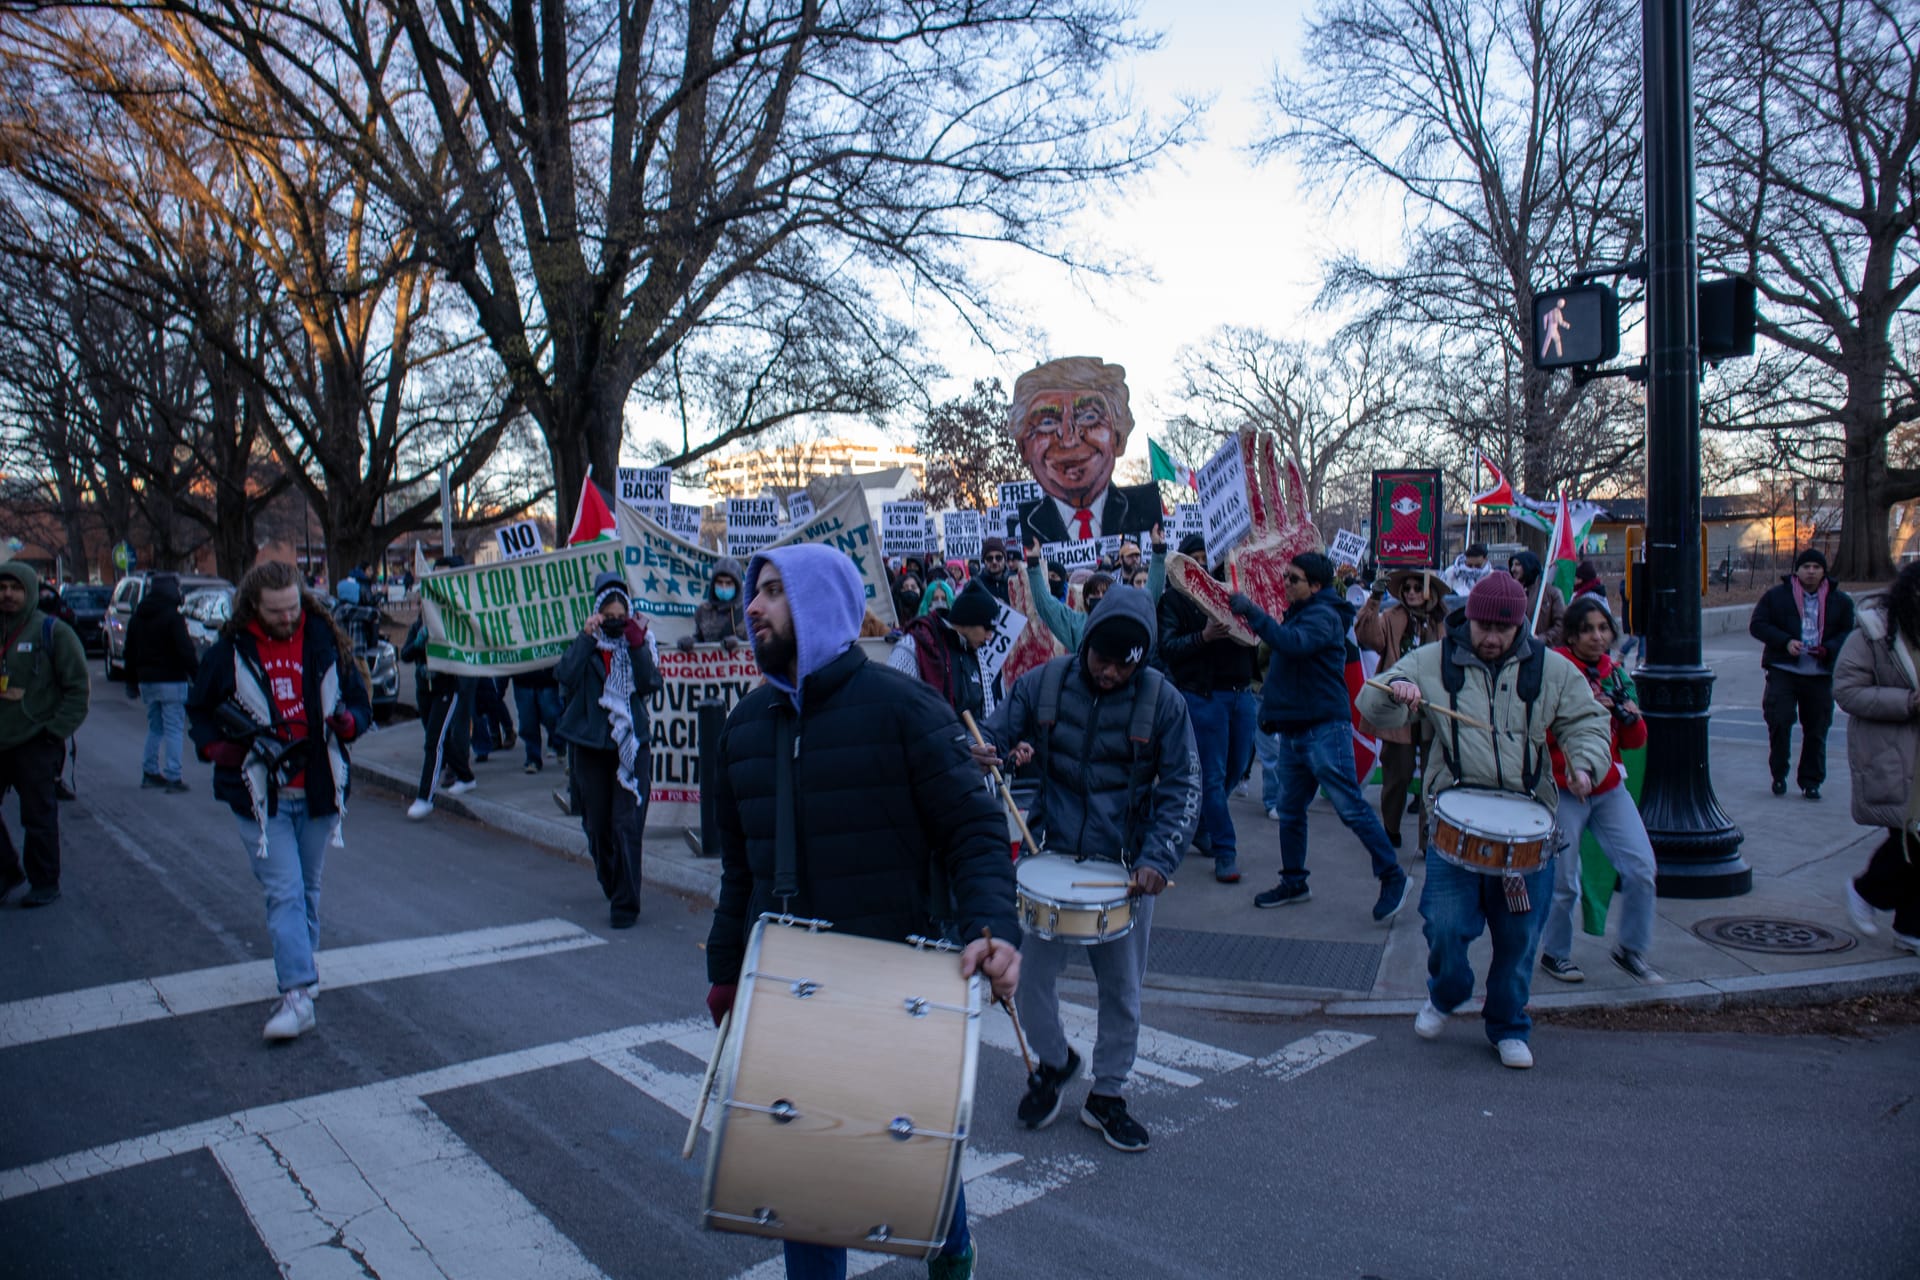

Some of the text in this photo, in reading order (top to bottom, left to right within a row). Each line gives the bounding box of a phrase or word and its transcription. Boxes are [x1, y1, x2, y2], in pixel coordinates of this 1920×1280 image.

[619, 469, 669, 482] WE FIGHT
[623, 482, 665, 500] BACK
[1001, 482, 1040, 501] FREE
[731, 500, 774, 513] DEFEAT
[883, 504, 924, 513] LA VIVIENDA
[728, 514, 778, 527] TRUMPS
[805, 516, 844, 539] WILL
[889, 514, 918, 526] ES UN
[501, 524, 535, 554] NO
[885, 529, 922, 539] DERECHO
[884, 540, 924, 551] HUMANO!
[946, 541, 980, 556] NOW!
[1056, 546, 1096, 565] BACK!
[476, 567, 519, 609] FOR
[520, 552, 609, 603] PEOPLE'S
[475, 605, 518, 649] THE
[518, 597, 568, 642] WAR
[463, 650, 482, 665] WE
[532, 643, 563, 658] BACK
[660, 650, 698, 664] NOR
[729, 662, 763, 677] FIG
[650, 681, 752, 713] OVERTY
